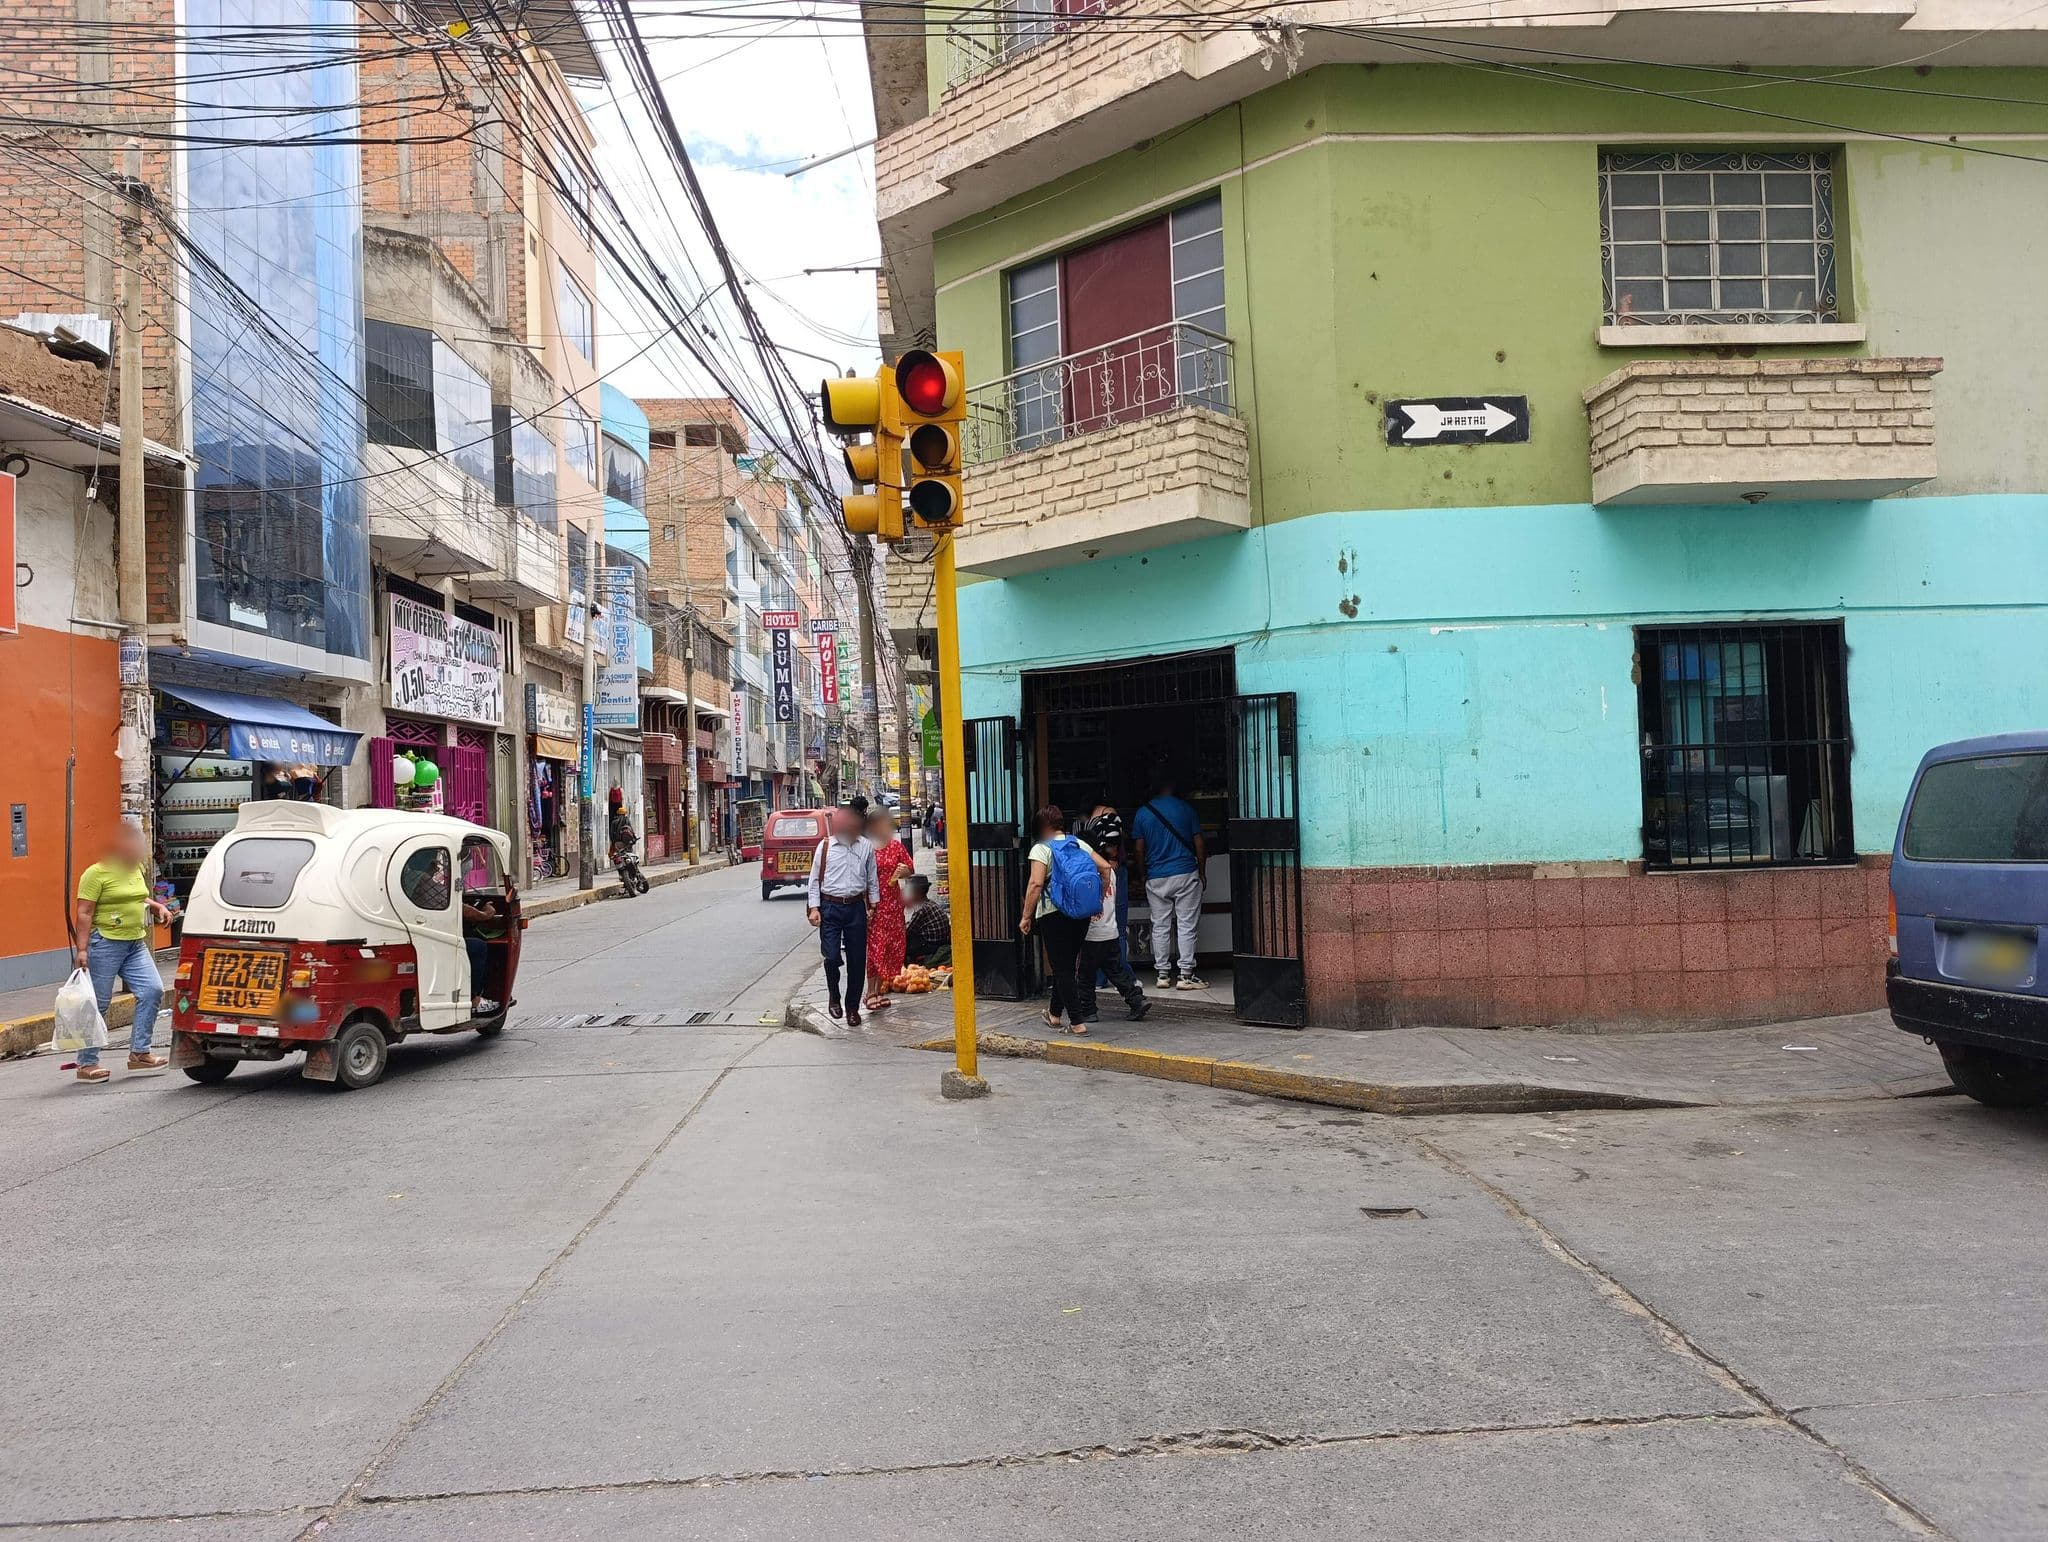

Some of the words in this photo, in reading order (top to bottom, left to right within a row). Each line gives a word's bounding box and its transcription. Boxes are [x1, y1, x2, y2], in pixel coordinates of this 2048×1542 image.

[412, 609, 448, 642] OFERTAS
[765, 615, 797, 626] HOTEL
[812, 620, 839, 632] CARIBE
[472, 671, 488, 684] TODO
[776, 632, 790, 720] SUMAC
[821, 636, 834, 701] HOTEL
[402, 666, 424, 704] 0.50
[601, 696, 632, 704] Dentist
[216, 990, 263, 1008] RUV
